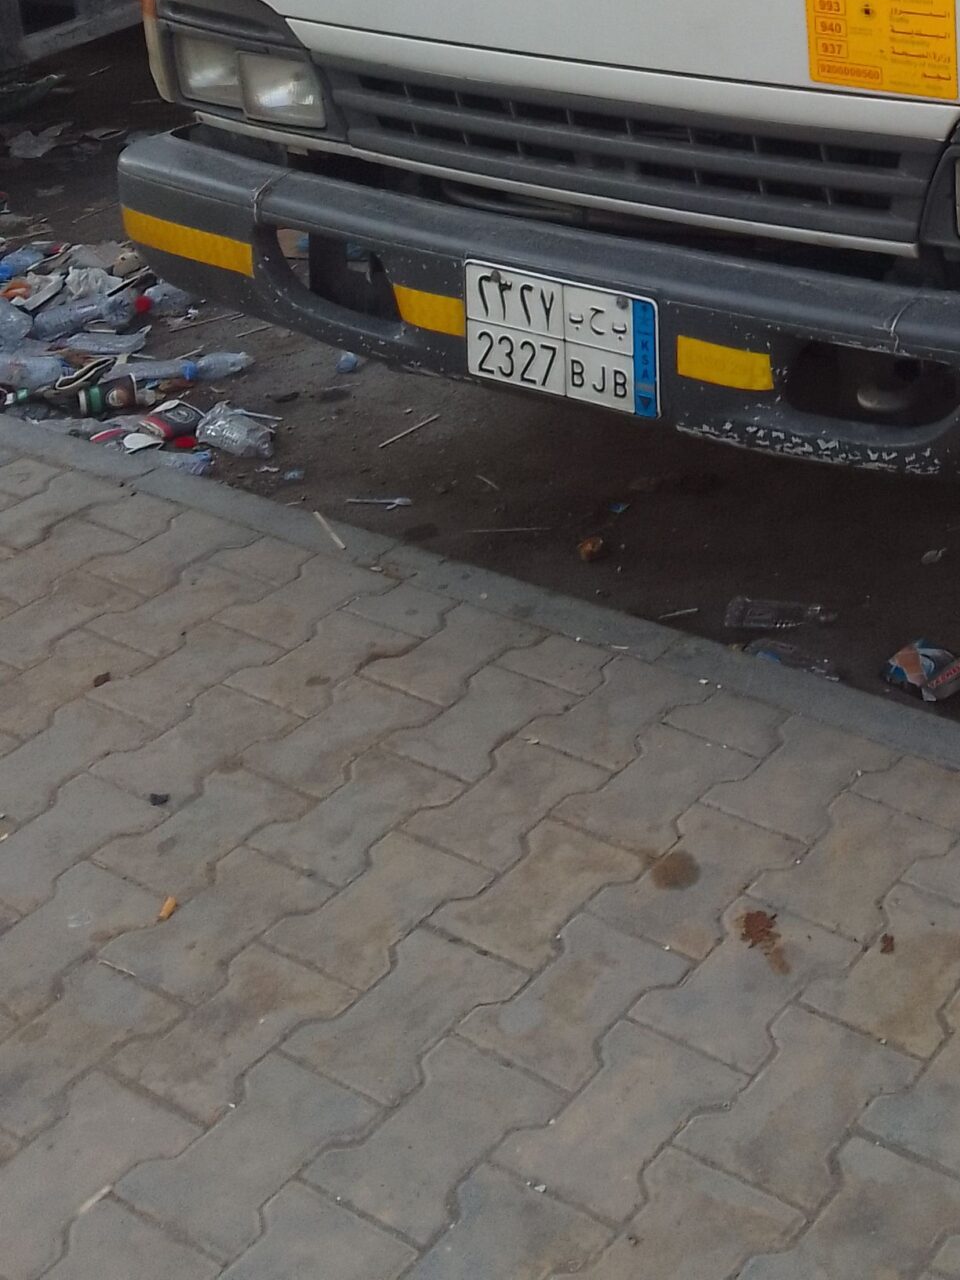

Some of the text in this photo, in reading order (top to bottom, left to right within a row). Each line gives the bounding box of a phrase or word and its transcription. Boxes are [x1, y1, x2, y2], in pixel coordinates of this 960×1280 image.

[820, 20, 842, 34] 940
[821, 42, 843, 55] 937
[478, 331, 628, 399] 2327 BJB
[640, 340, 650, 380] KSA
